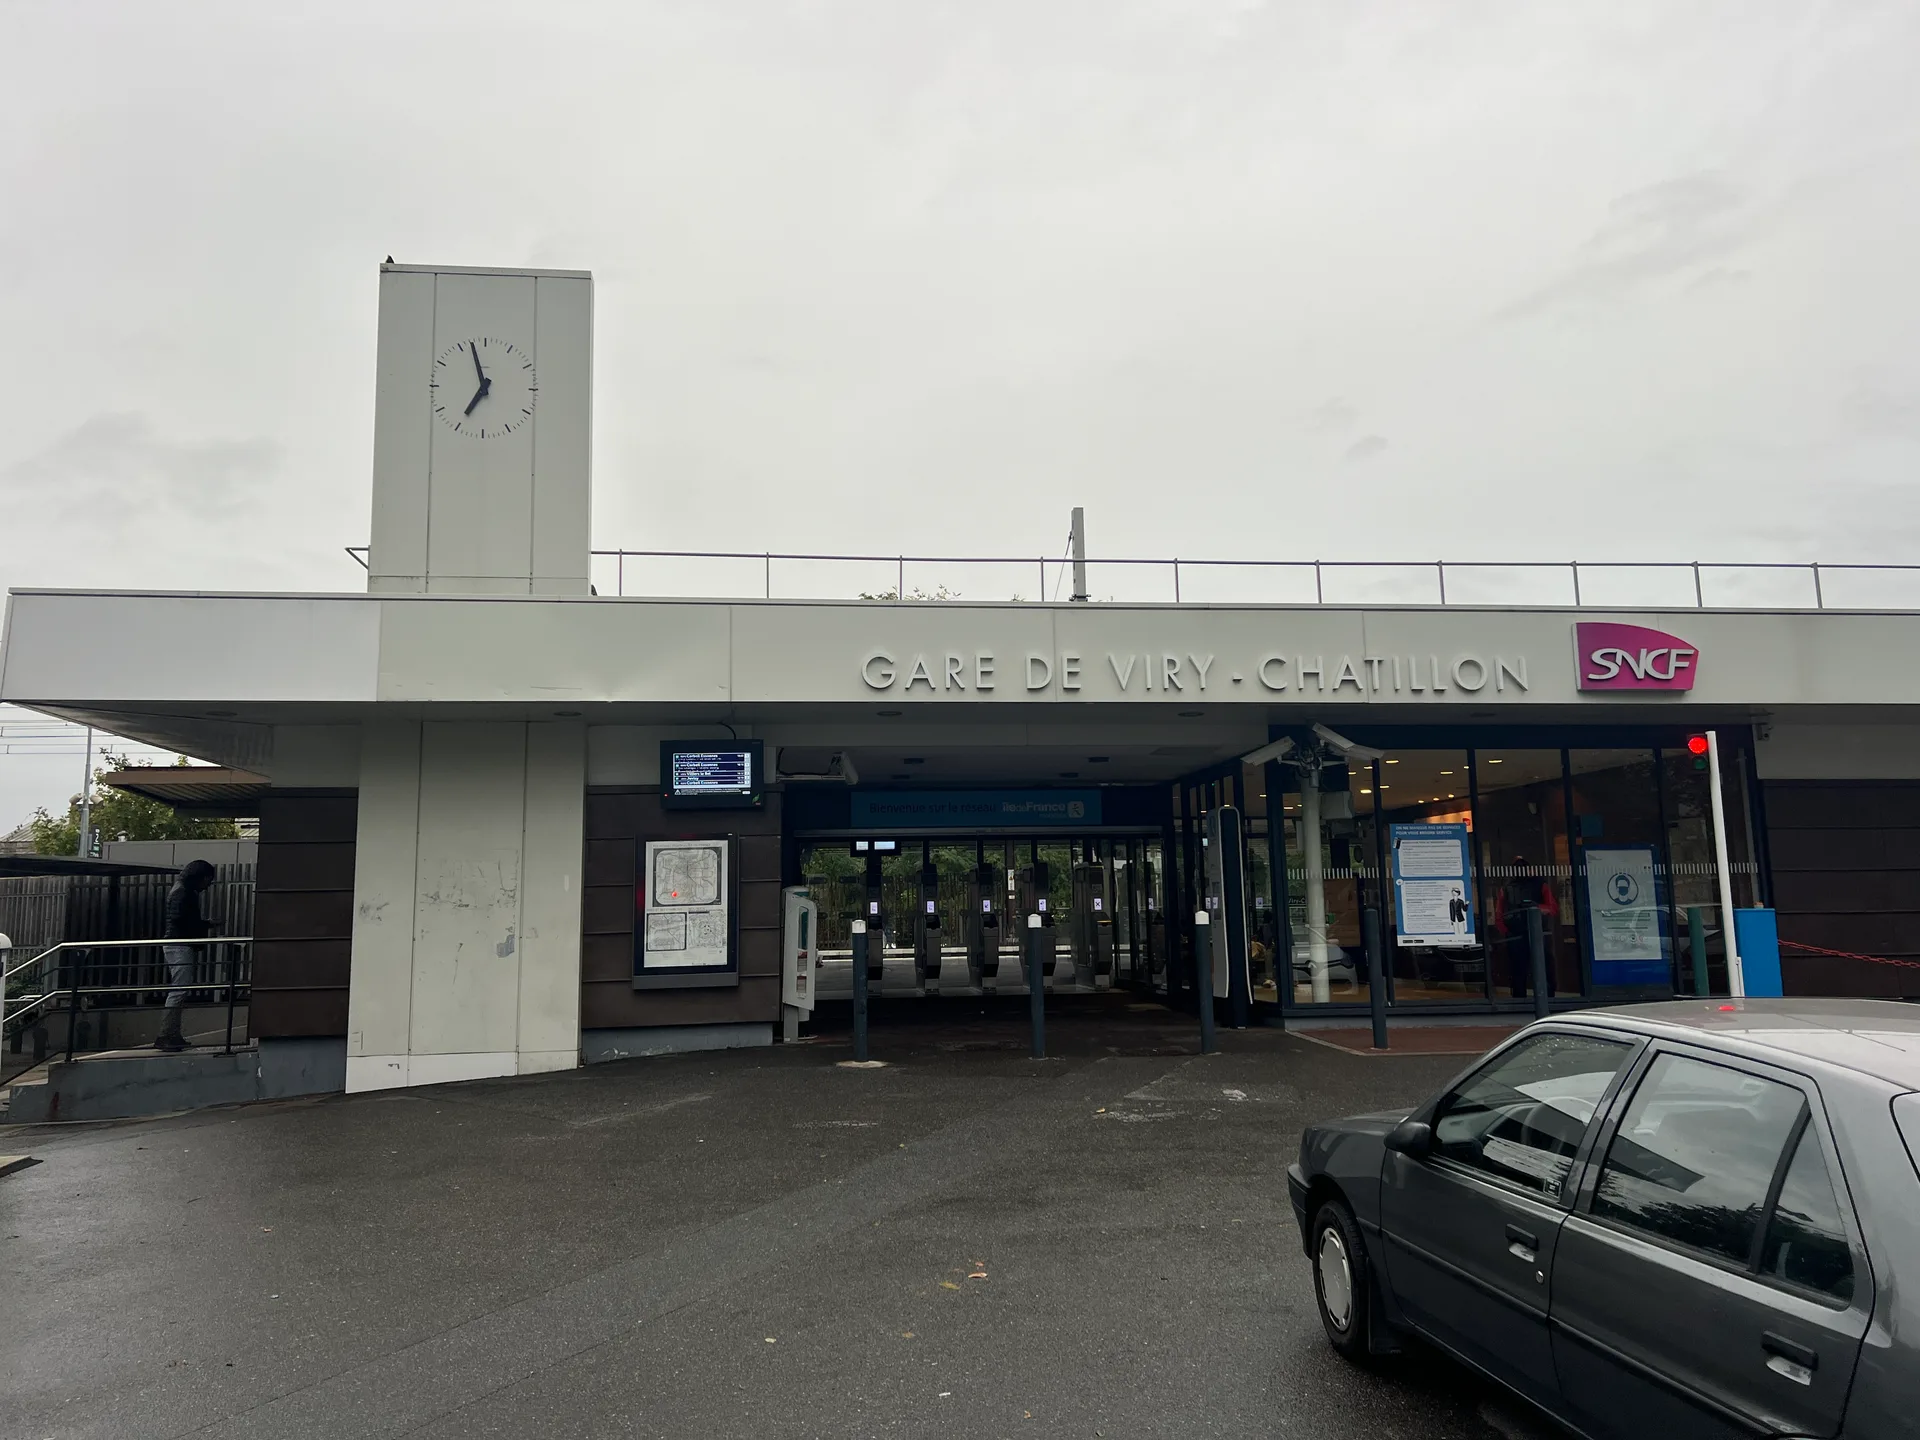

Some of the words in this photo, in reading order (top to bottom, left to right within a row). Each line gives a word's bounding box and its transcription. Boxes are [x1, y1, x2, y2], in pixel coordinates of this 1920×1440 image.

[861, 653, 995, 690] GARE
[1025, 655, 1082, 690] DE
[1108, 653, 1215, 691] VIRY
[1257, 654, 1528, 692] CHATILLON
[1587, 648, 1695, 680] SNCF
[869, 802, 926, 814] Bienvenue
[929, 804, 945, 814] sur
[948, 802, 957, 814] le
[961, 802, 996, 814] réseau
